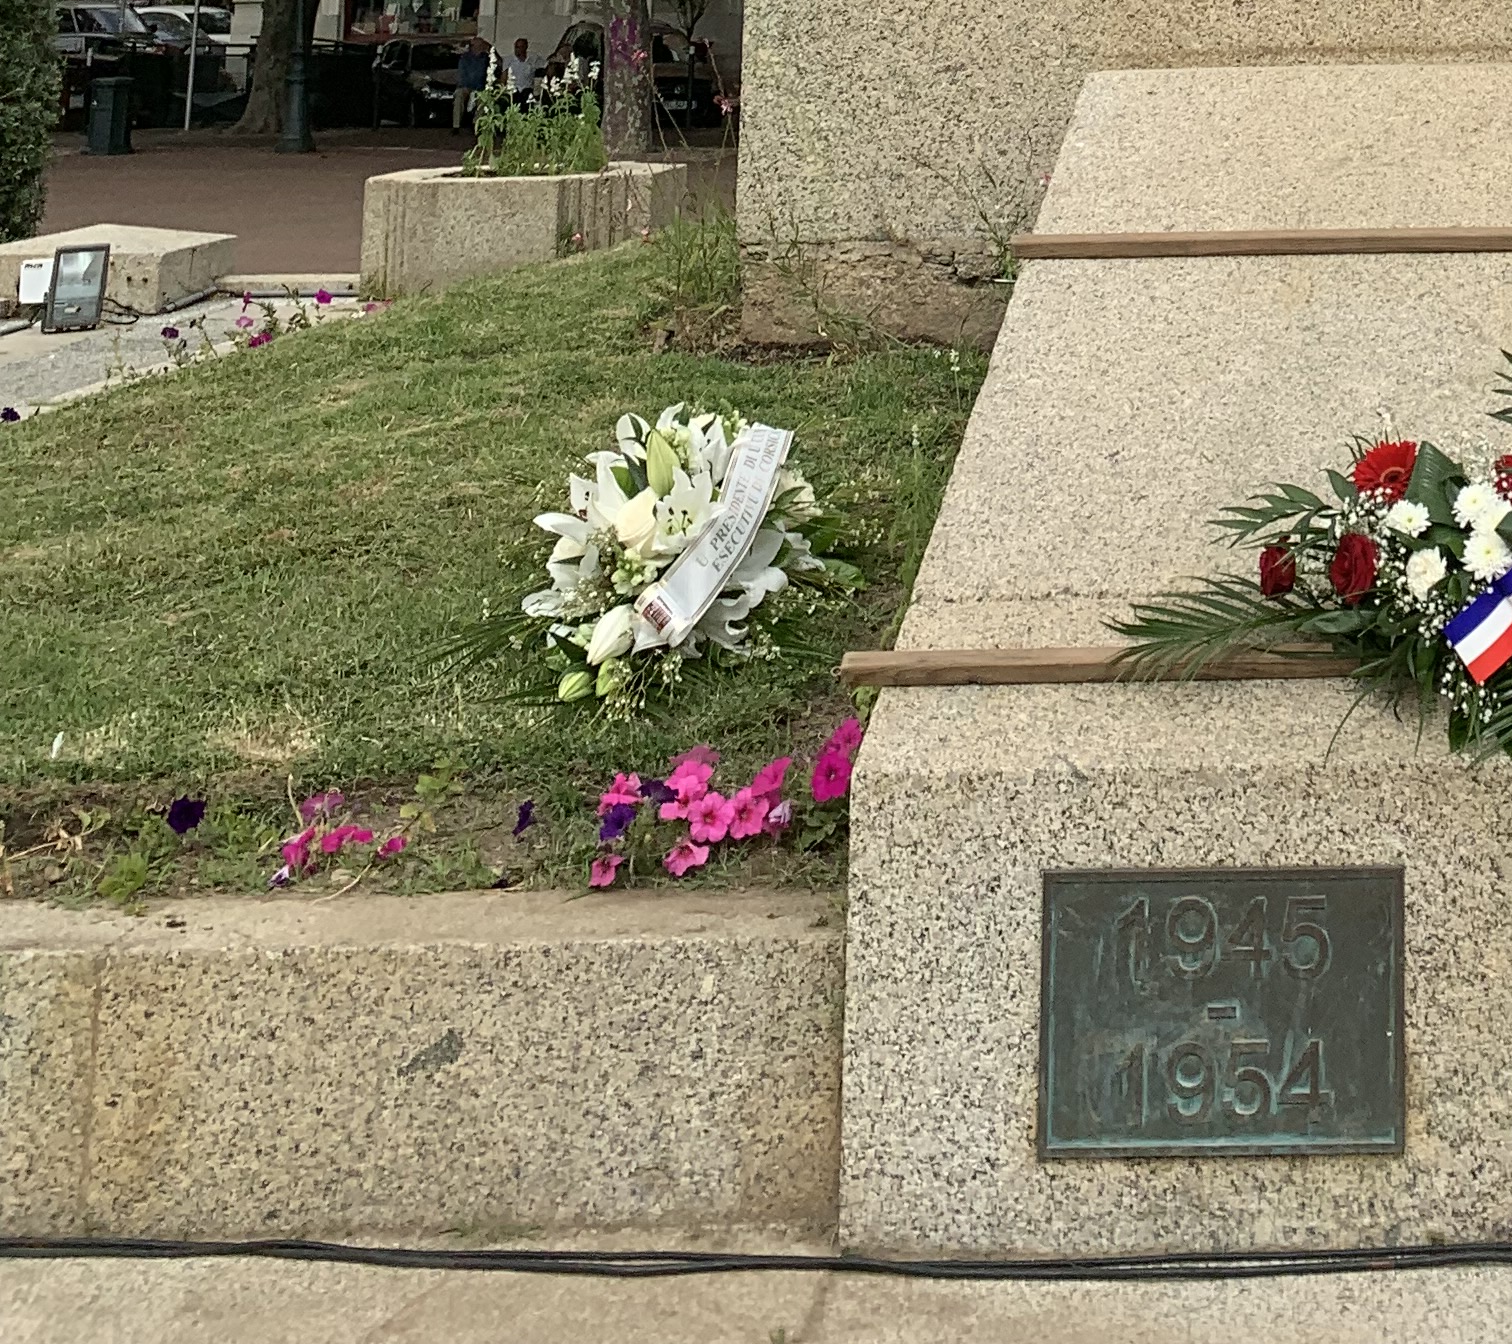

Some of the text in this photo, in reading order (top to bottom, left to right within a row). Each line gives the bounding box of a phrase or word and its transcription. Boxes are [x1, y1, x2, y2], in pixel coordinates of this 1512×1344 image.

[696, 552, 708, 568] U
[1113, 894, 1332, 981] 1945
[1112, 1037, 1336, 1127] 1954
